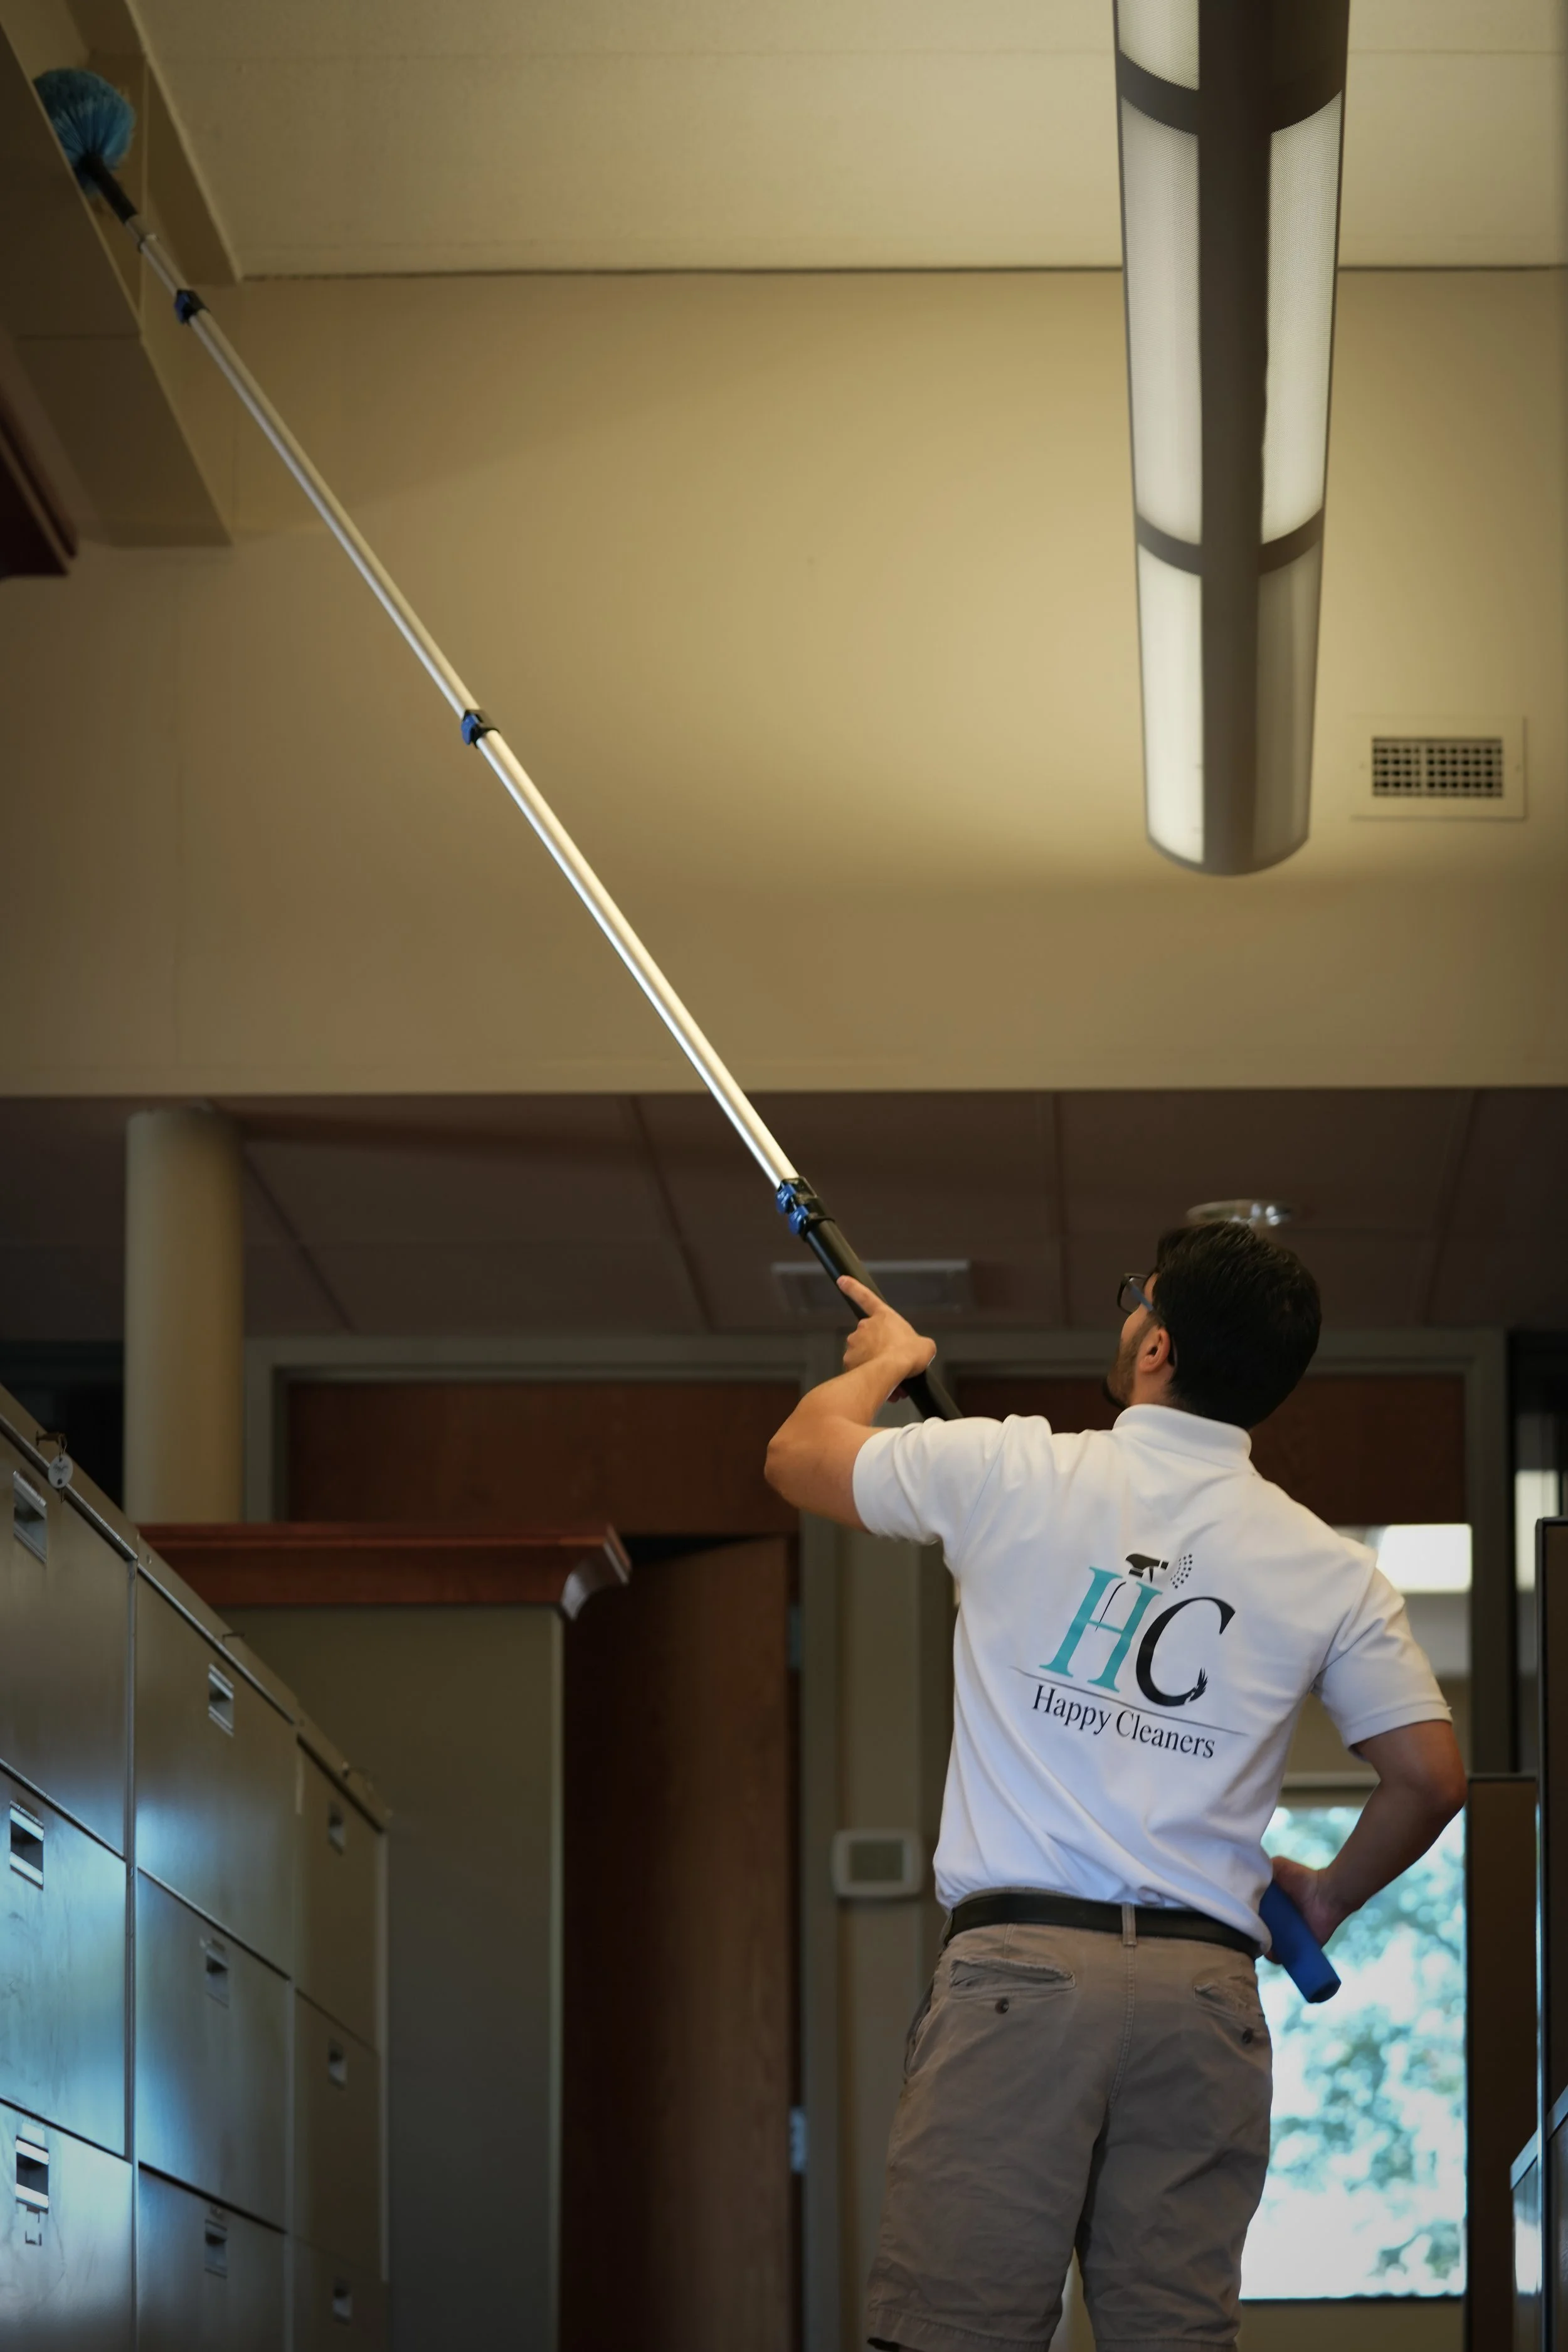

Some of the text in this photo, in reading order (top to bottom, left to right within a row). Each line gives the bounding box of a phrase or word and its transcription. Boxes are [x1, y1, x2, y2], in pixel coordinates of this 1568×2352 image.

[1039, 1565, 1236, 1708] HC
[1032, 1683, 1216, 1758] Happy Cleaners
